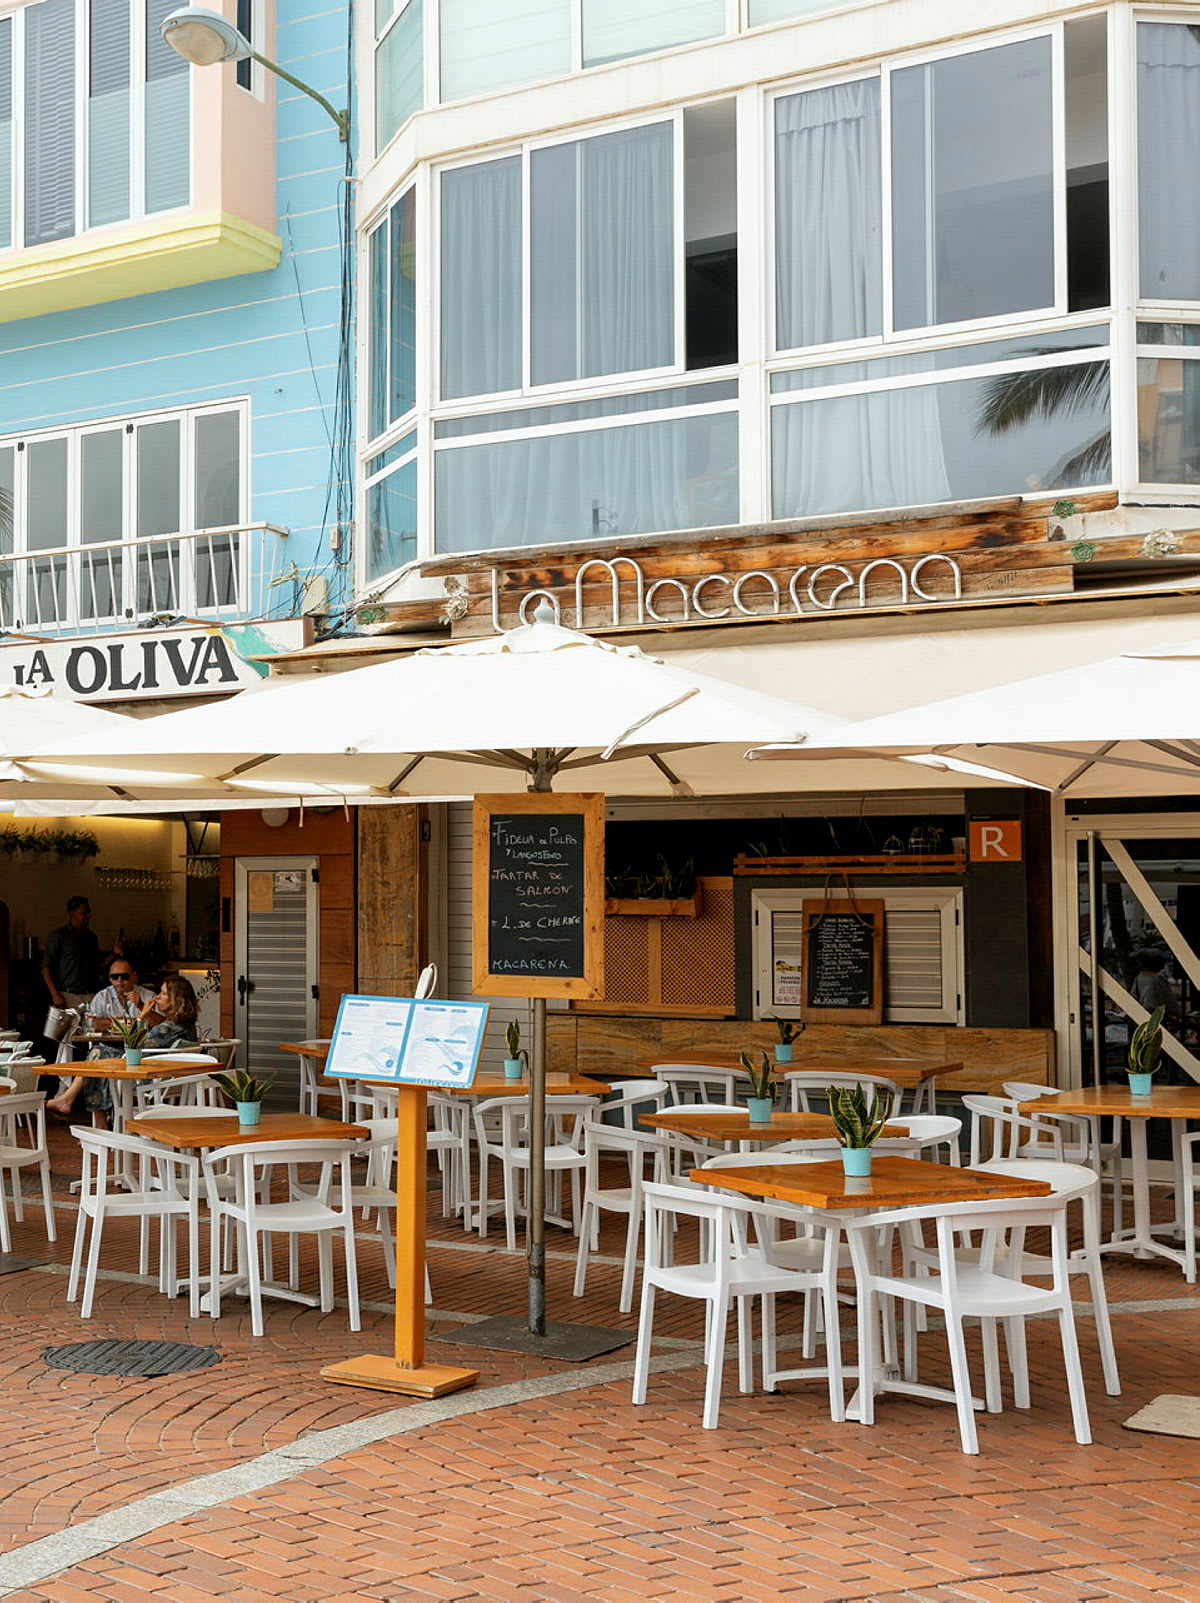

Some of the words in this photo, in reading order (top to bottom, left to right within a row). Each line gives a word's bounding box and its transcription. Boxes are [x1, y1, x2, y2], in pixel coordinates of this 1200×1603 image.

[492, 569, 560, 634] La
[575, 554, 962, 629] Macarena
[13, 649, 55, 689] LA
[65, 635, 240, 694] OLIVA
[981, 827, 1009, 857] R
[492, 959, 568, 970] MACARENA
